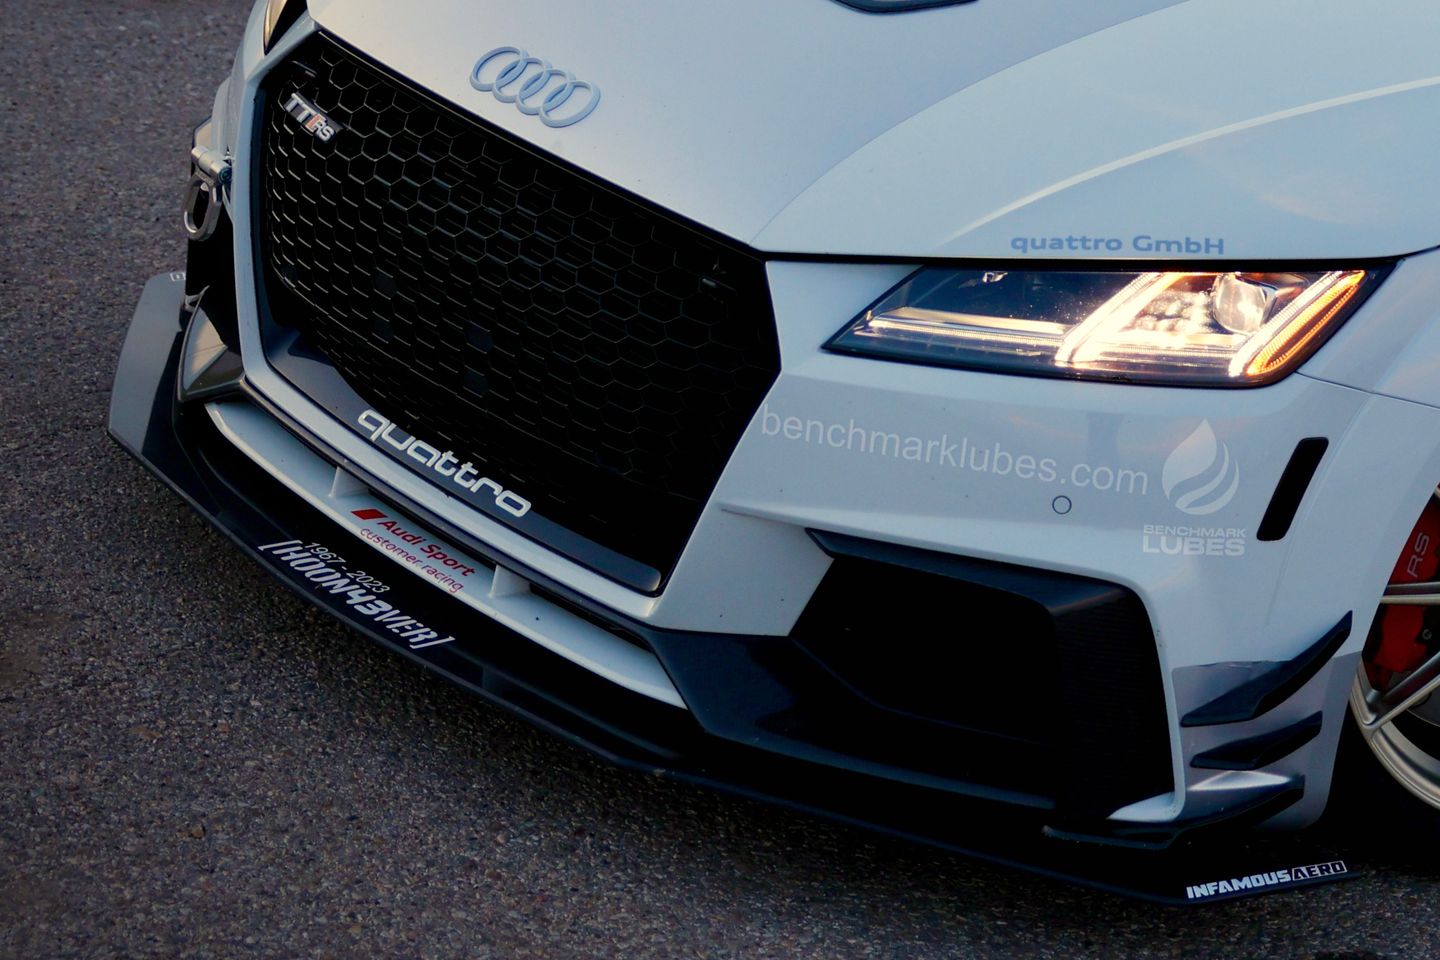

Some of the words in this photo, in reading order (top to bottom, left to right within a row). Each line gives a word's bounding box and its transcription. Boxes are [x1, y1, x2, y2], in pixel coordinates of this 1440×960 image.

[1010, 236, 1123, 255] quattro
[1132, 235, 1225, 255] GmbH
[357, 409, 532, 518] quattro
[760, 402, 1148, 496] benchmarklubes.com
[377, 518, 424, 545] Audi
[420, 543, 478, 577] Sport
[1142, 524, 1247, 539] BENCHMARK
[1142, 537, 1247, 557] LUBES
[1406, 531, 1430, 578] RS
[304, 542, 344, 567] 1967
[348, 569, 391, 594] 2023
[360, 526, 422, 570] customer
[422, 562, 465, 594] racing
